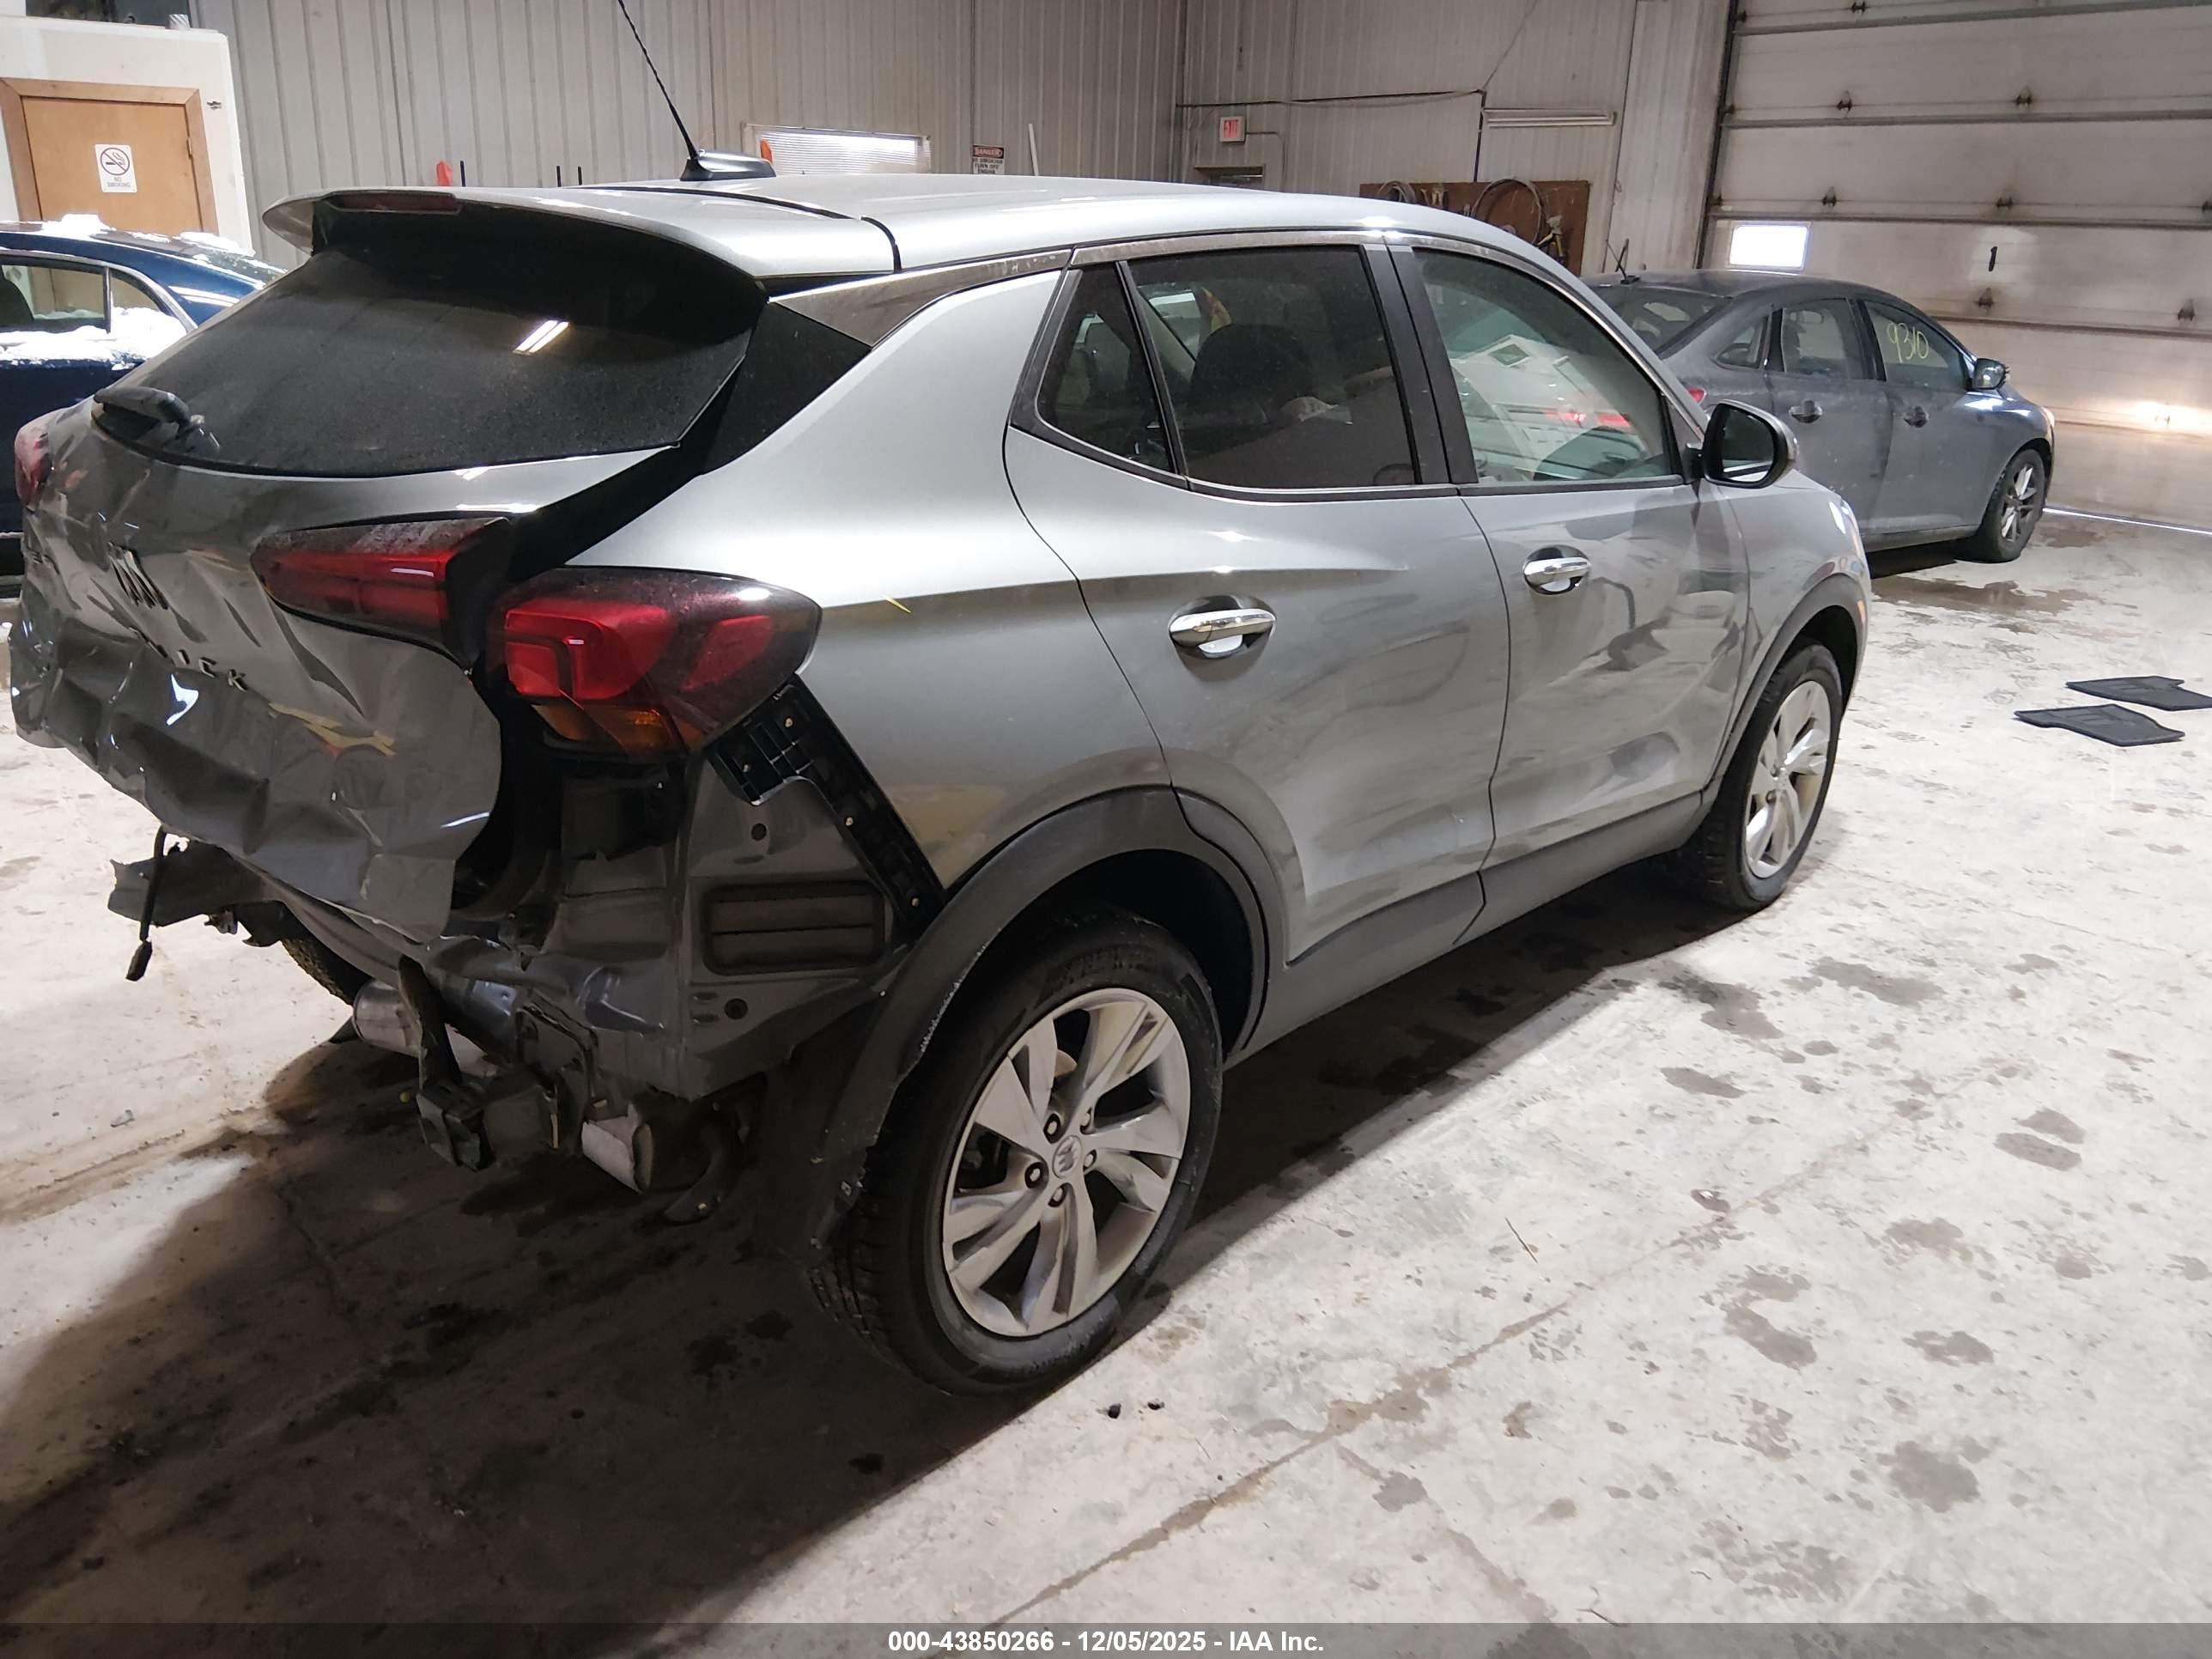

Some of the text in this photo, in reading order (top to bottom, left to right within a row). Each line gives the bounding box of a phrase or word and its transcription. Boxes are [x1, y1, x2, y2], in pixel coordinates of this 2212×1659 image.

[1223, 118, 1238, 137] EXIT
[975, 147, 1000, 156] DANGER
[1988, 246, 1997, 271] 1
[1887, 321, 1929, 363] 9310
